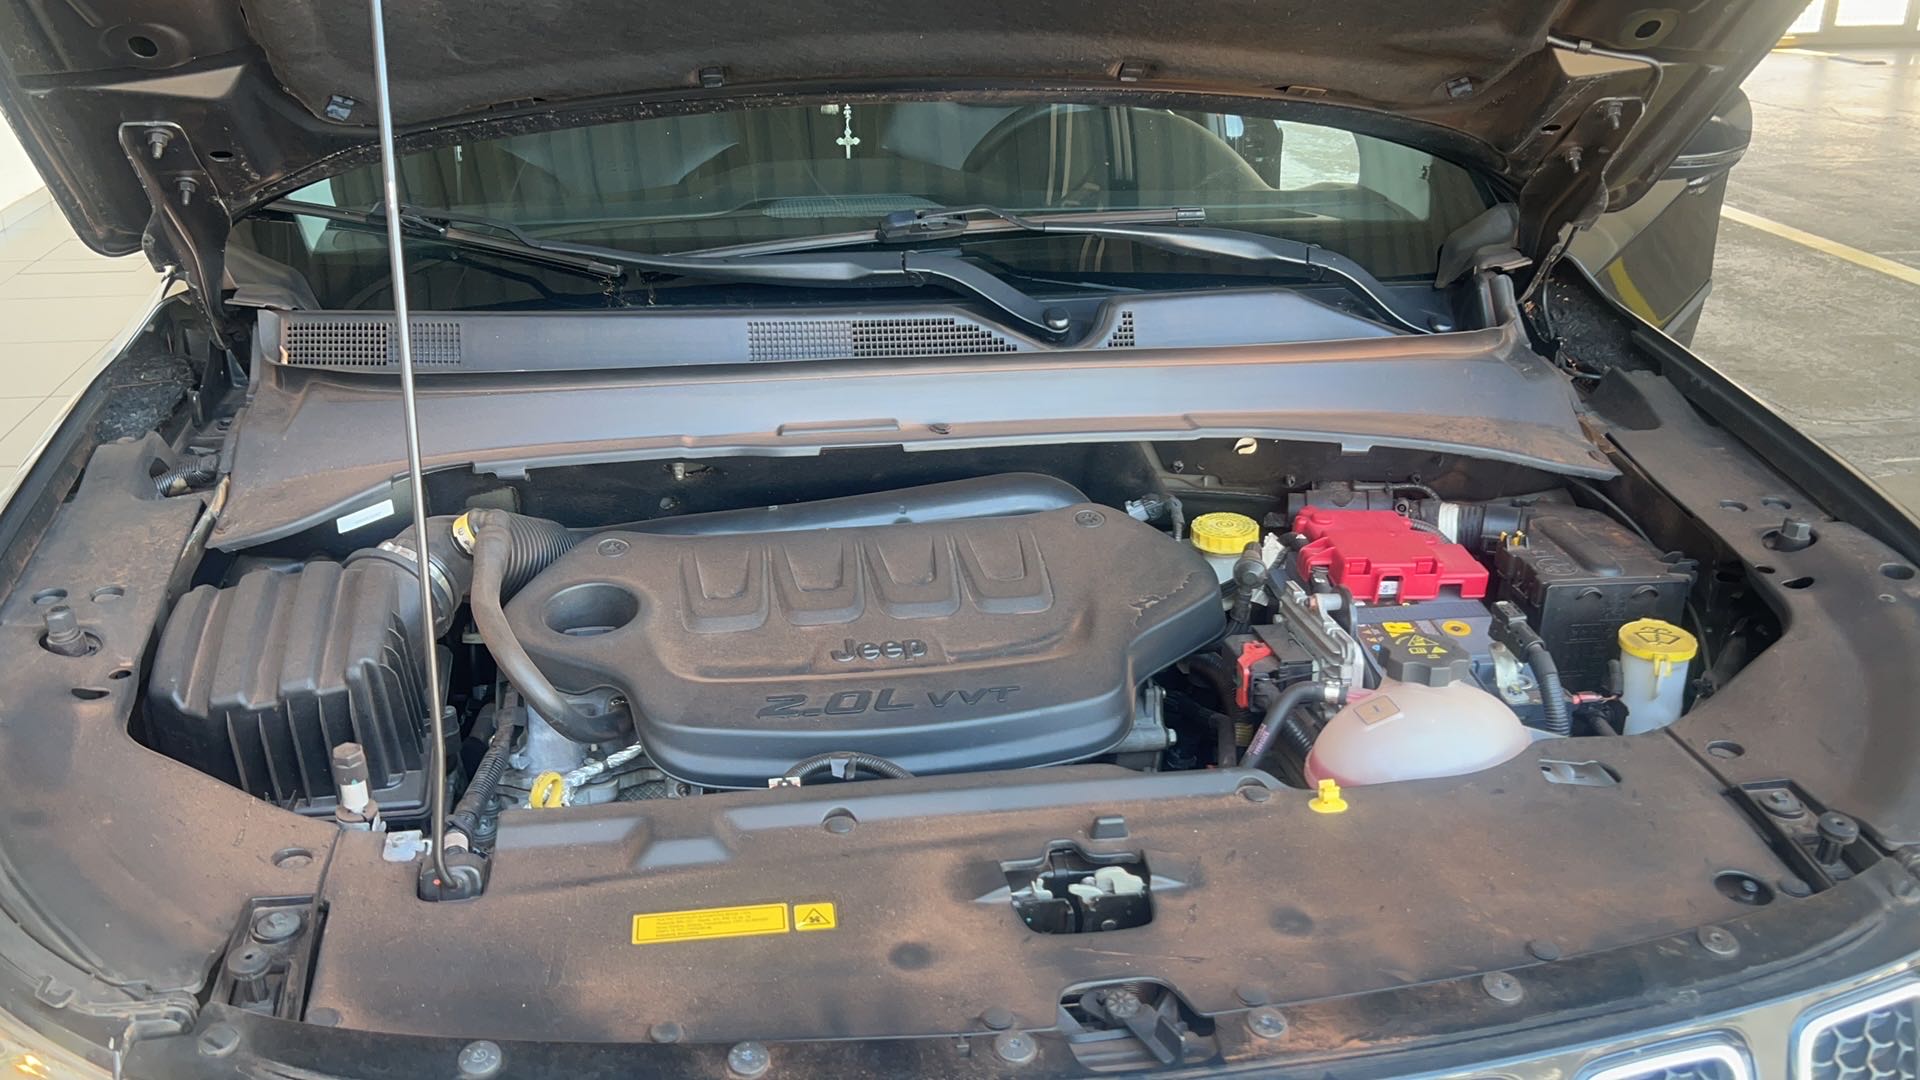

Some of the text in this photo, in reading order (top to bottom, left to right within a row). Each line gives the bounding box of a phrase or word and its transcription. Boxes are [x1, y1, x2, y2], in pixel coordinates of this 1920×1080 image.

[830, 638, 928, 663] Jeep
[757, 685, 1021, 719] 2.0L VVT
